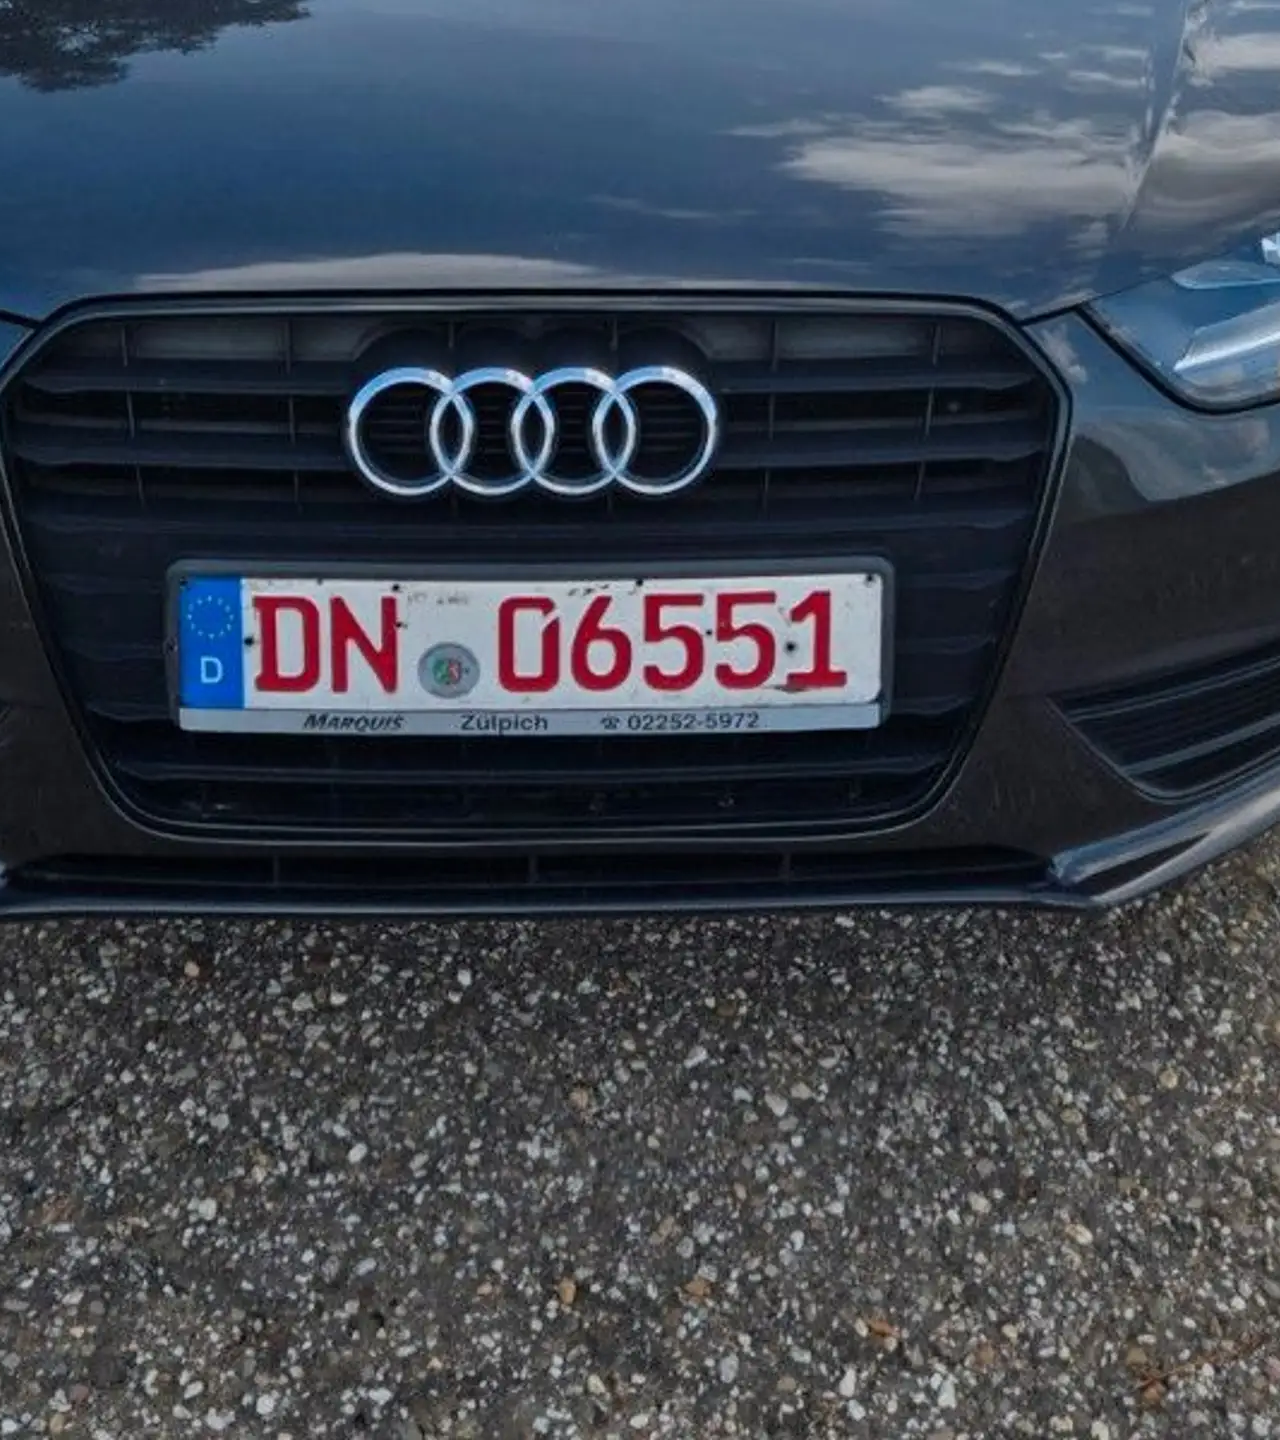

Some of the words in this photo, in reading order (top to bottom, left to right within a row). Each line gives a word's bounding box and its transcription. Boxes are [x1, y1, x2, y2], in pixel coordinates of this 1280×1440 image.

[252, 596, 398, 693] DN
[497, 591, 848, 693] 06551
[200, 656, 223, 683] D
[460, 714, 549, 735] Zülpich
[627, 711, 761, 730] 02252-5972
